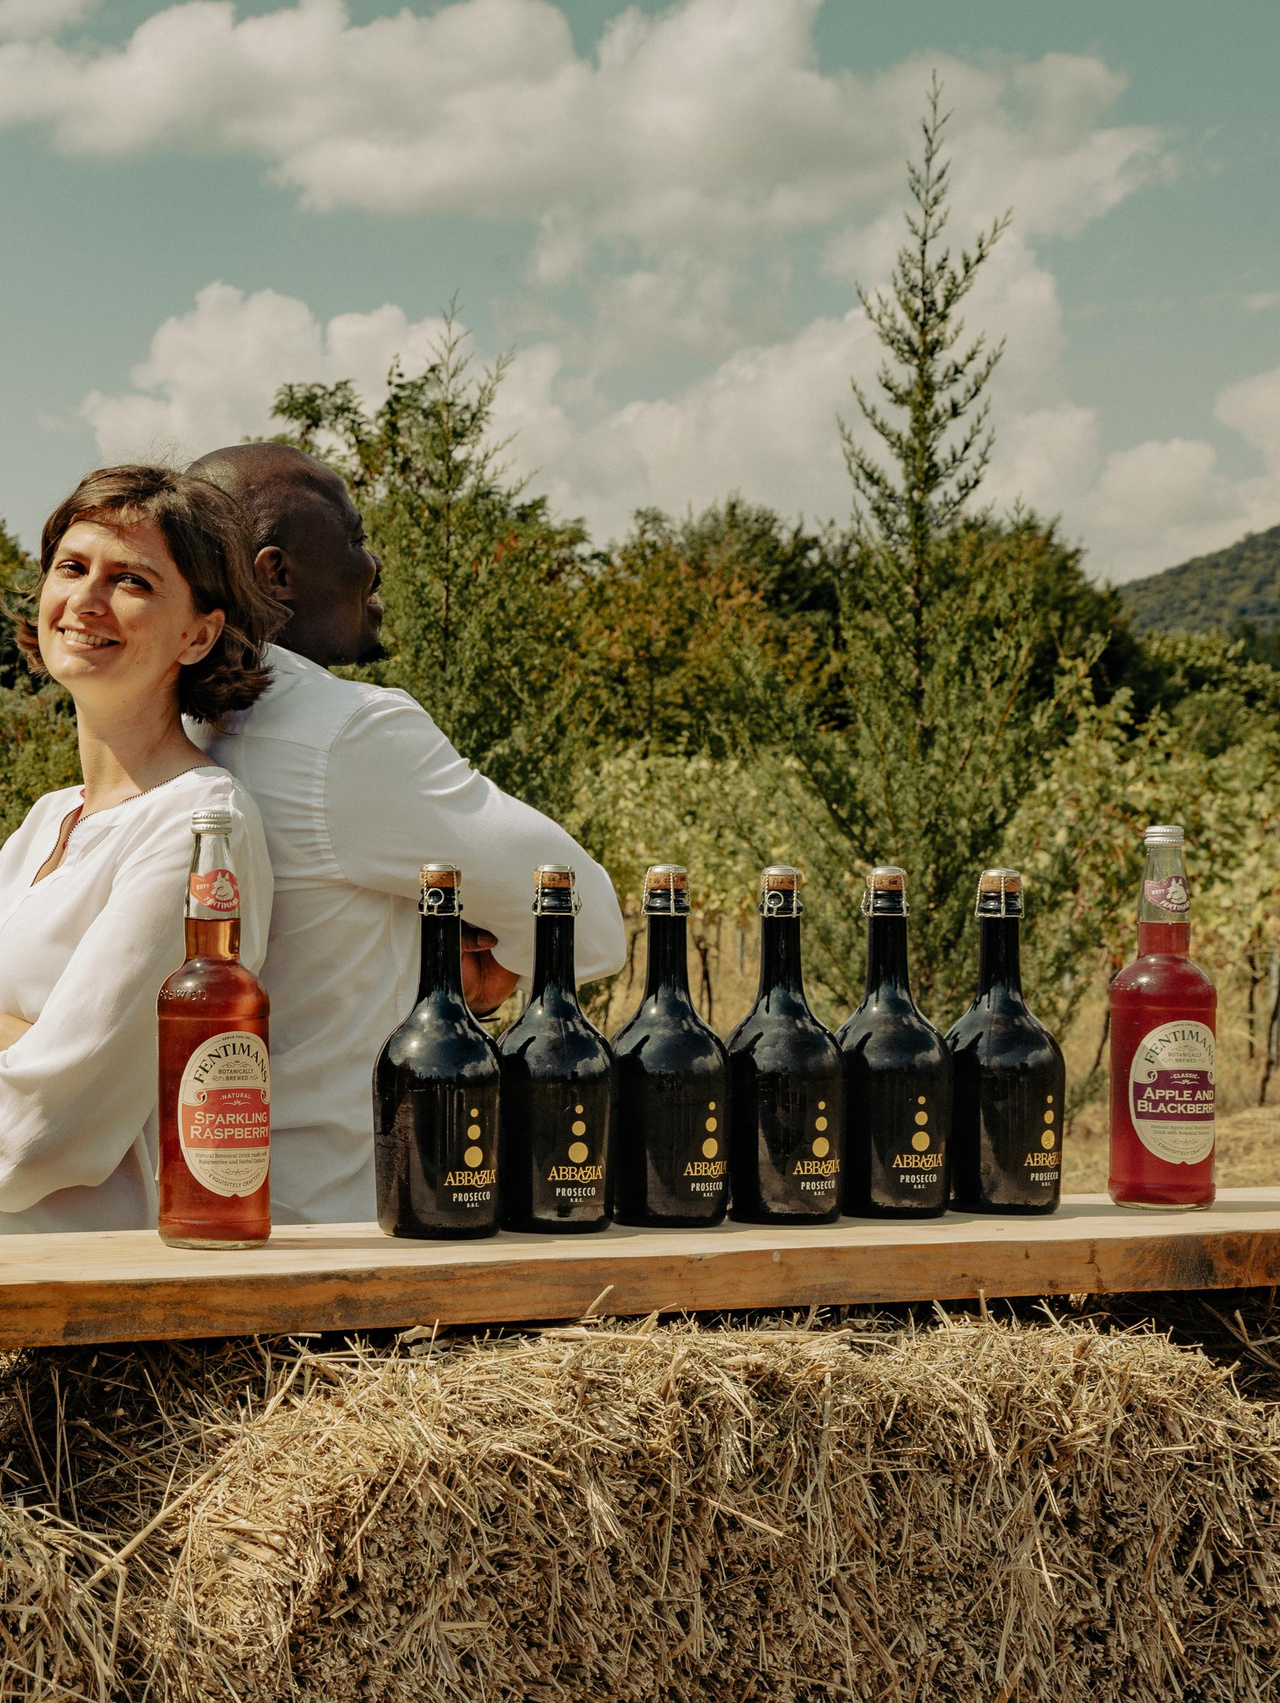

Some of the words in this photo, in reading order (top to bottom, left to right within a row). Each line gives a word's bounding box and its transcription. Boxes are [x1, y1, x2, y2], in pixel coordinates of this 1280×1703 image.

[1144, 1030, 1214, 1066] FENTIMANS
[193, 1042, 267, 1083] FENTIMANS
[1142, 1087, 1192, 1100] APPLE
[1194, 1090, 1214, 1100] AND
[194, 1111, 268, 1125] SPARKLING
[190, 1125, 269, 1139] RASPBERRY
[792, 1159, 840, 1176] ABBAZIA
[892, 1153, 942, 1171] ABBAZIA
[208, 1173, 241, 1188] EXQUISITELY
[444, 1169, 496, 1188] ABBAZIA
[547, 1165, 603, 1184] ABBAZIA
[900, 1174, 938, 1184] PROSECCO
[1030, 1172, 1059, 1181] PROSECCO
[556, 1187, 596, 1196] PROSECCO
[691, 1182, 722, 1192] PROSECCO
[800, 1180, 836, 1190] PROSECCO
[452, 1191, 491, 1202] PROSECCO
